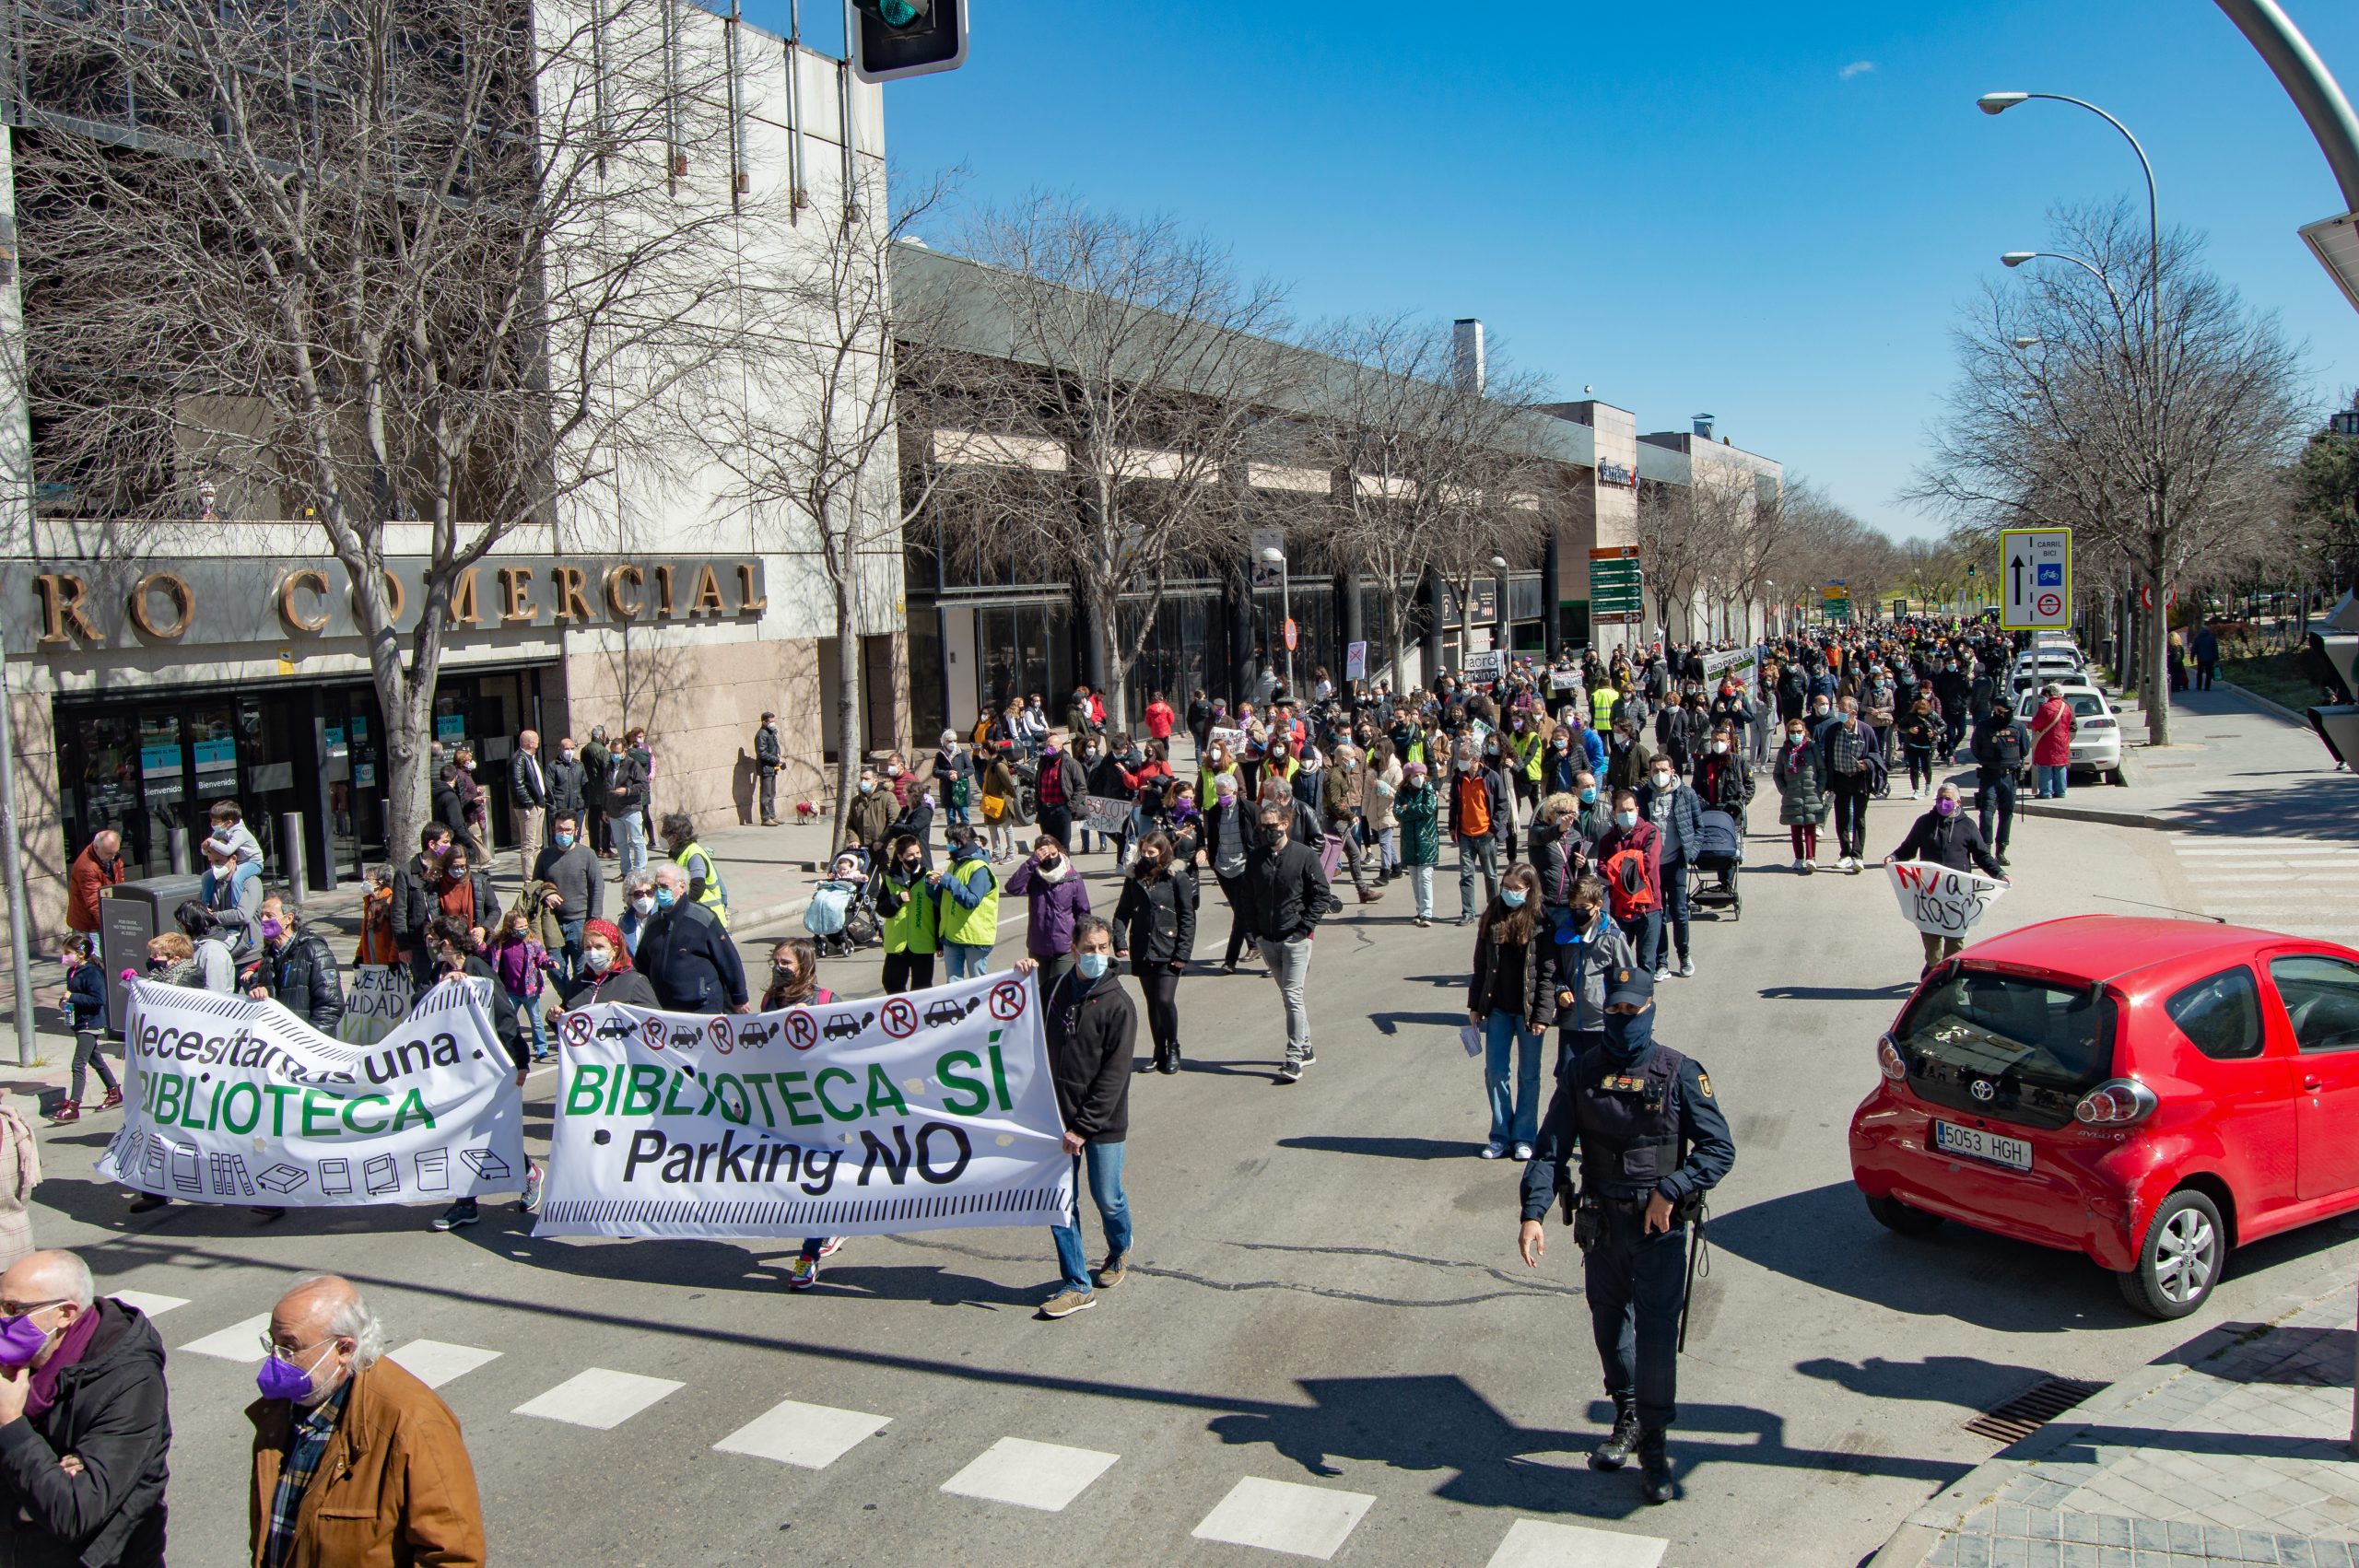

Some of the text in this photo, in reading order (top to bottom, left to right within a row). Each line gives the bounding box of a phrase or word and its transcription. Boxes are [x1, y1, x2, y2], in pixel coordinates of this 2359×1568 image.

[1708, 651, 1754, 673] USO PARA EL
[144, 784, 182, 797] Bienvenido
[198, 778, 237, 790] Bienvenido
[1087, 798, 1130, 818] BOICOT
[344, 993, 405, 1020] ALIDAD
[364, 1032, 462, 1085] una
[564, 1028, 1014, 1128] BIBLIOTECA SÍ
[139, 1070, 437, 1138] BIBLIOTECA
[623, 1121, 973, 1197] Parking NO
[1945, 1126, 1982, 1152] 5053
[1991, 1137, 2023, 1163] HGH
